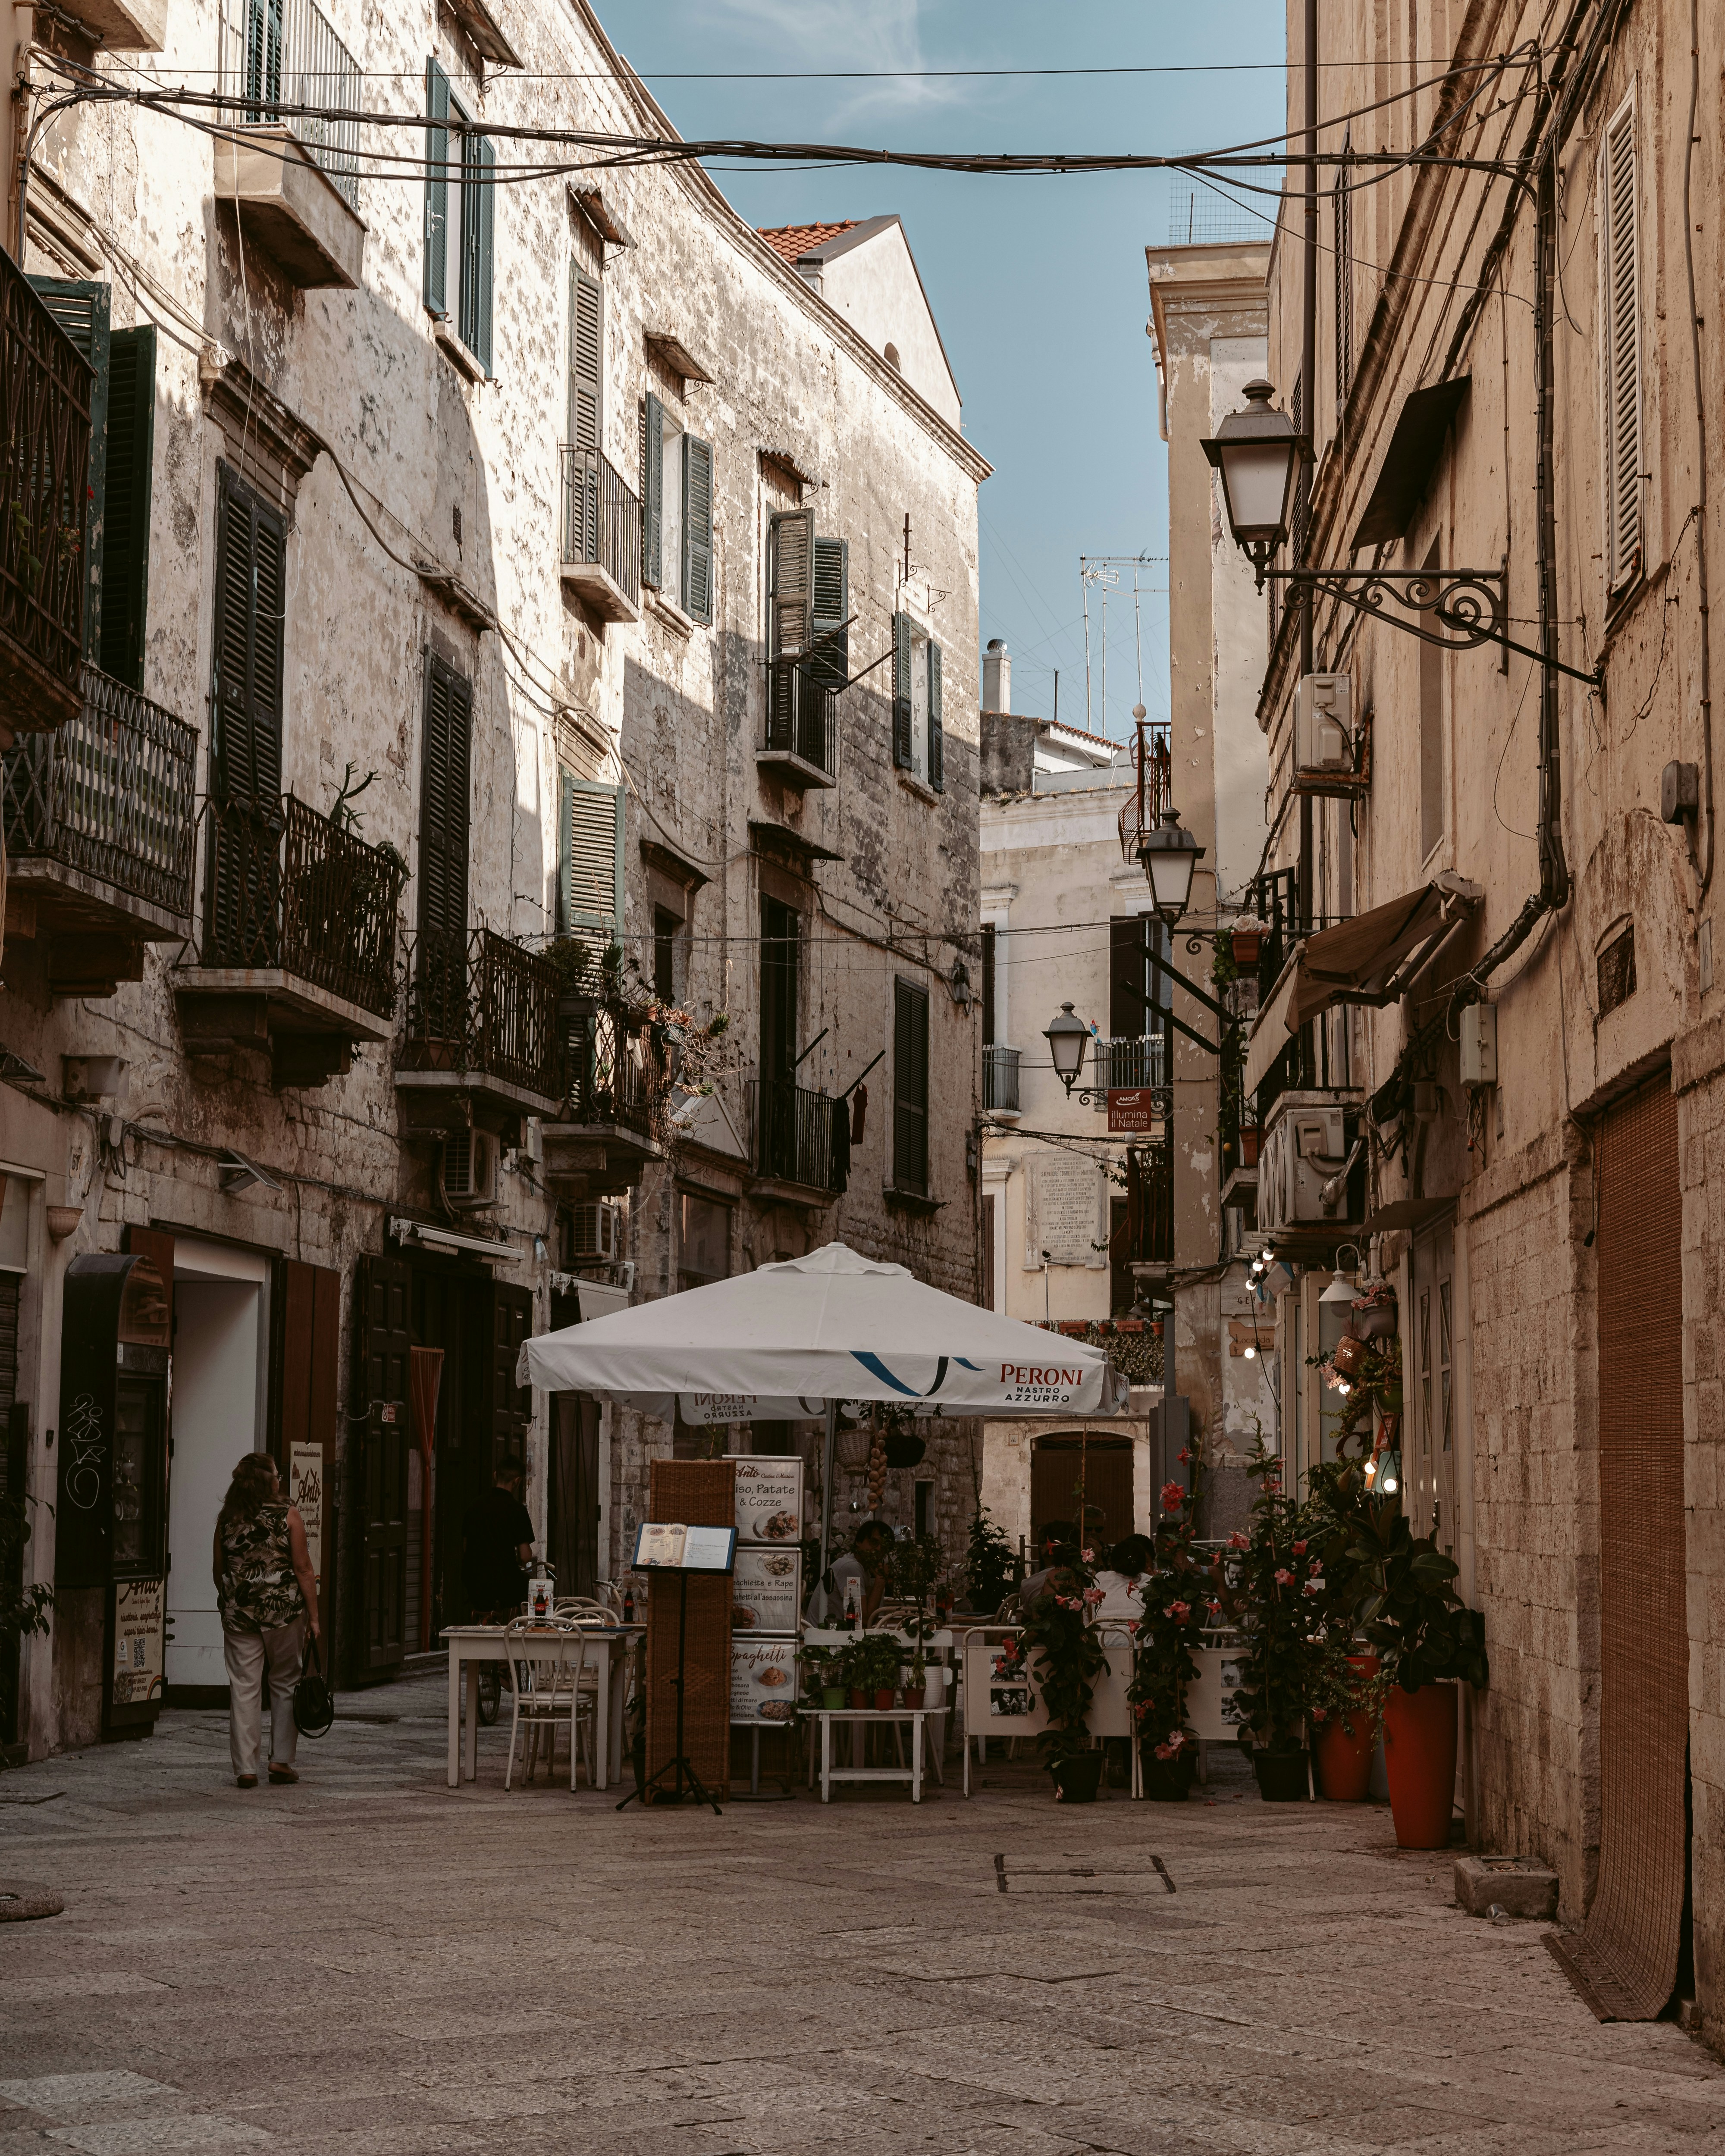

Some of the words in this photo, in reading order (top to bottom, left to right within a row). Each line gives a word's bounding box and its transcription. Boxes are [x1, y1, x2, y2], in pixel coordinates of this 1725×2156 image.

[1112, 1110, 1147, 1119] illumina
[1112, 1119, 1116, 1128] il
[1119, 1119, 1148, 1128] Natale
[1000, 1363, 1083, 1385] PERONI
[1005, 1394, 1070, 1402] AZZURRO
[735, 1465, 760, 1478] Antò
[297, 1467, 321, 1503] Antò
[736, 1484, 754, 1495] iso,
[757, 1484, 795, 1494] Patate
[749, 1496, 781, 1507] Cozze
[775, 1579, 794, 1589] Rape
[753, 1593, 793, 1601] all'assassina
